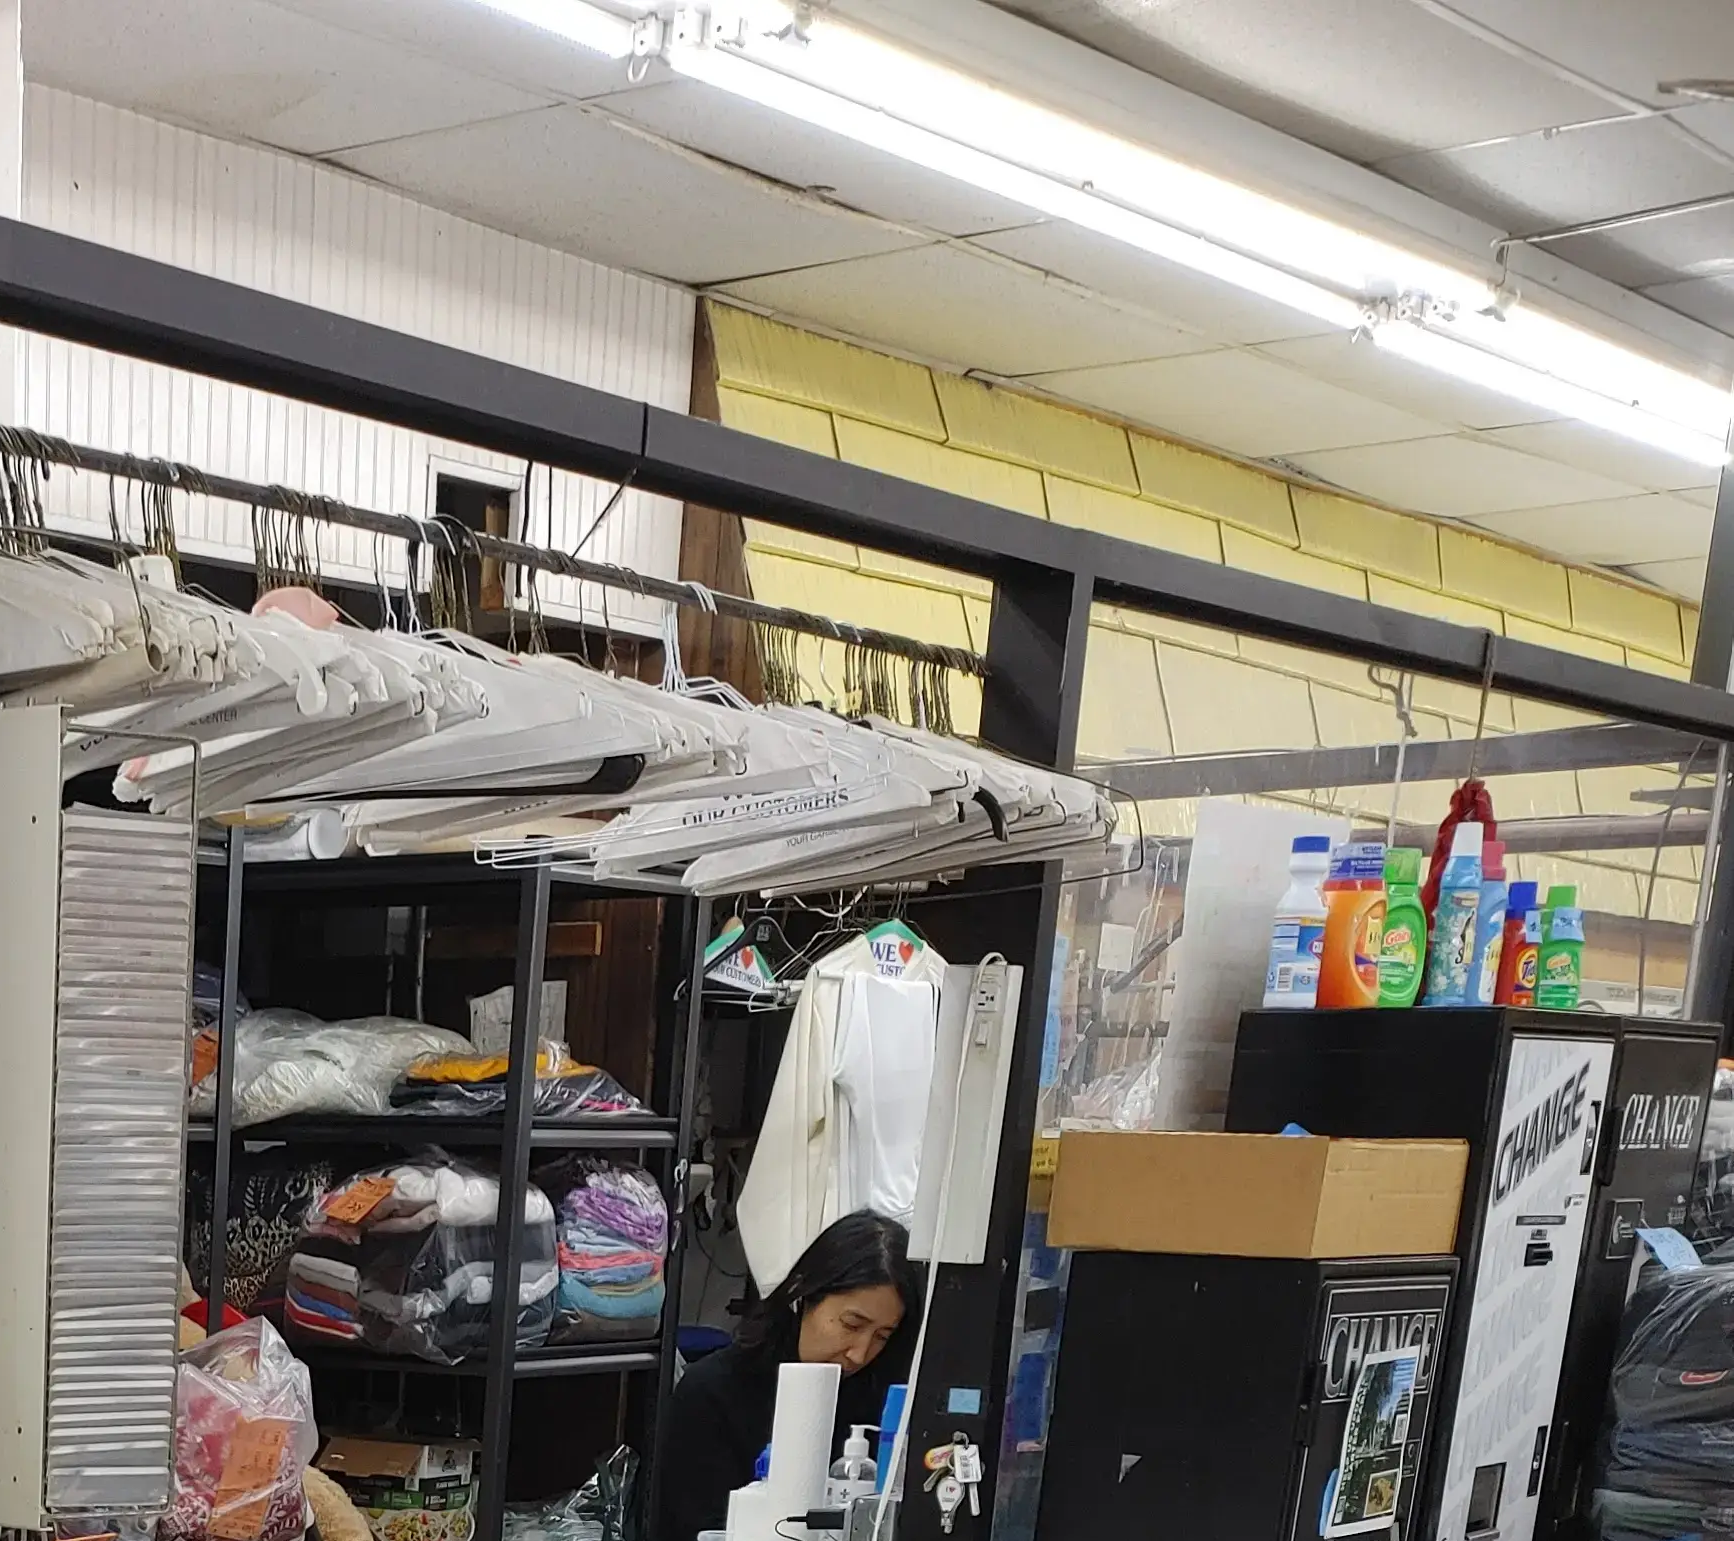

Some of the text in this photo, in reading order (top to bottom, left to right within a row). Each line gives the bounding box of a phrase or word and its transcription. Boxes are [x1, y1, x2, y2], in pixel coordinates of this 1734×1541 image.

[870, 942, 896, 962] WE
[1493, 1060, 1590, 1207] CHANGE
[1619, 1094, 1700, 1150] CHANGE
